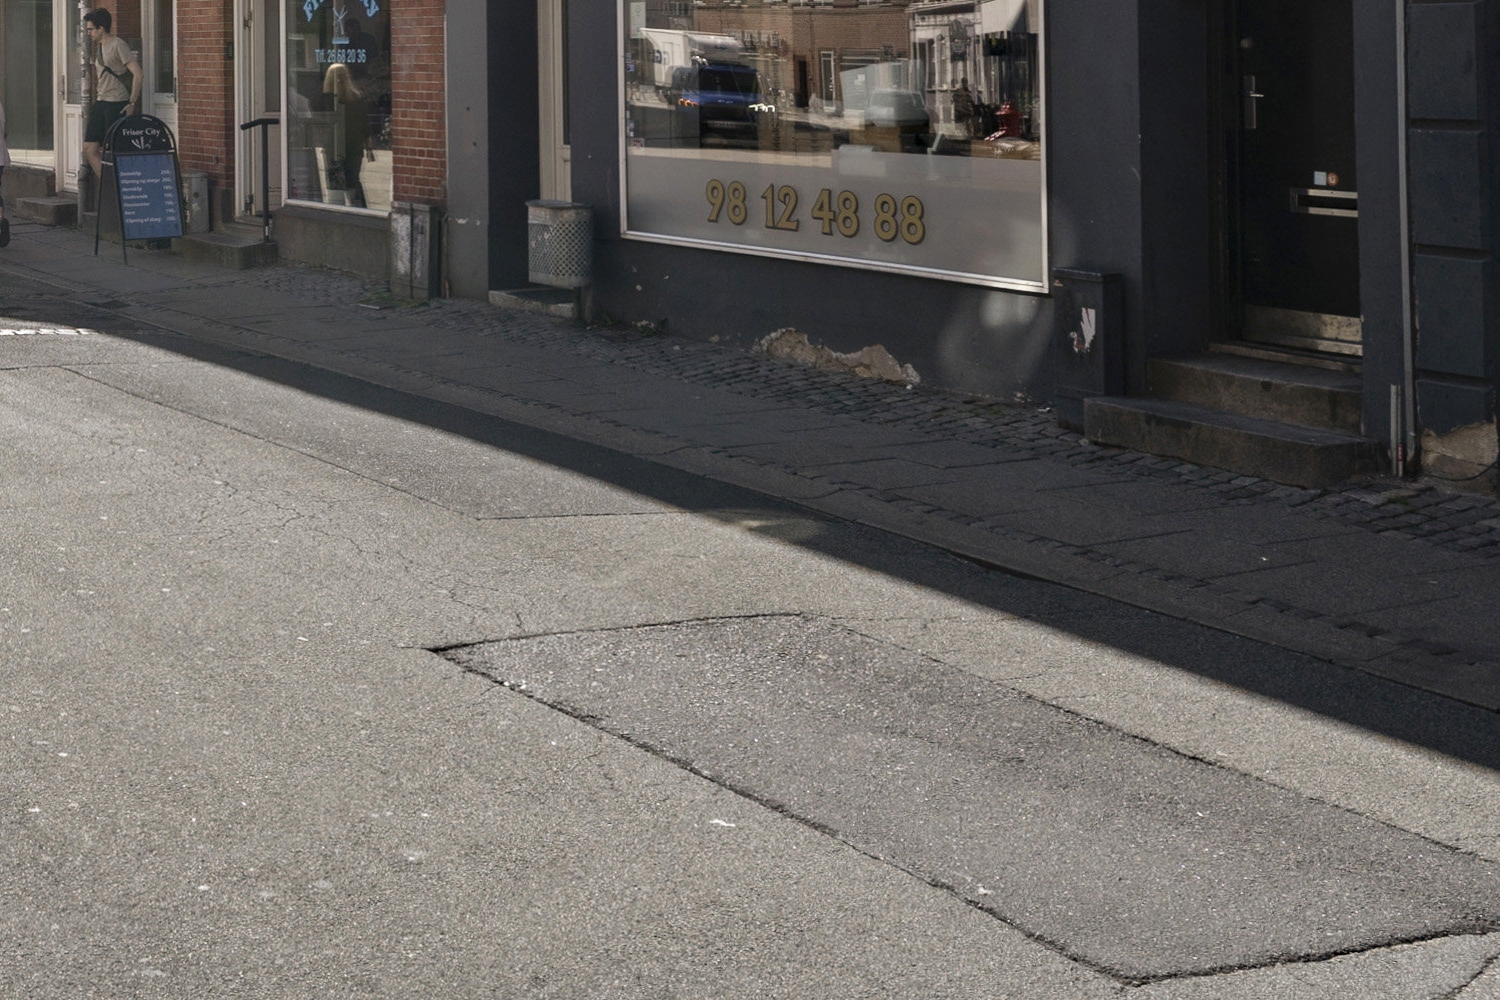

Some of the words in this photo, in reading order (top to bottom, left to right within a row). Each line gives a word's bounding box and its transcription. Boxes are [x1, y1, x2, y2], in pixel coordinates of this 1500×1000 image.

[145, 127, 161, 137] City
[706, 178, 747, 225] 98
[761, 183, 799, 232] 12
[811, 188, 860, 237] 48
[874, 193, 925, 245] 88
